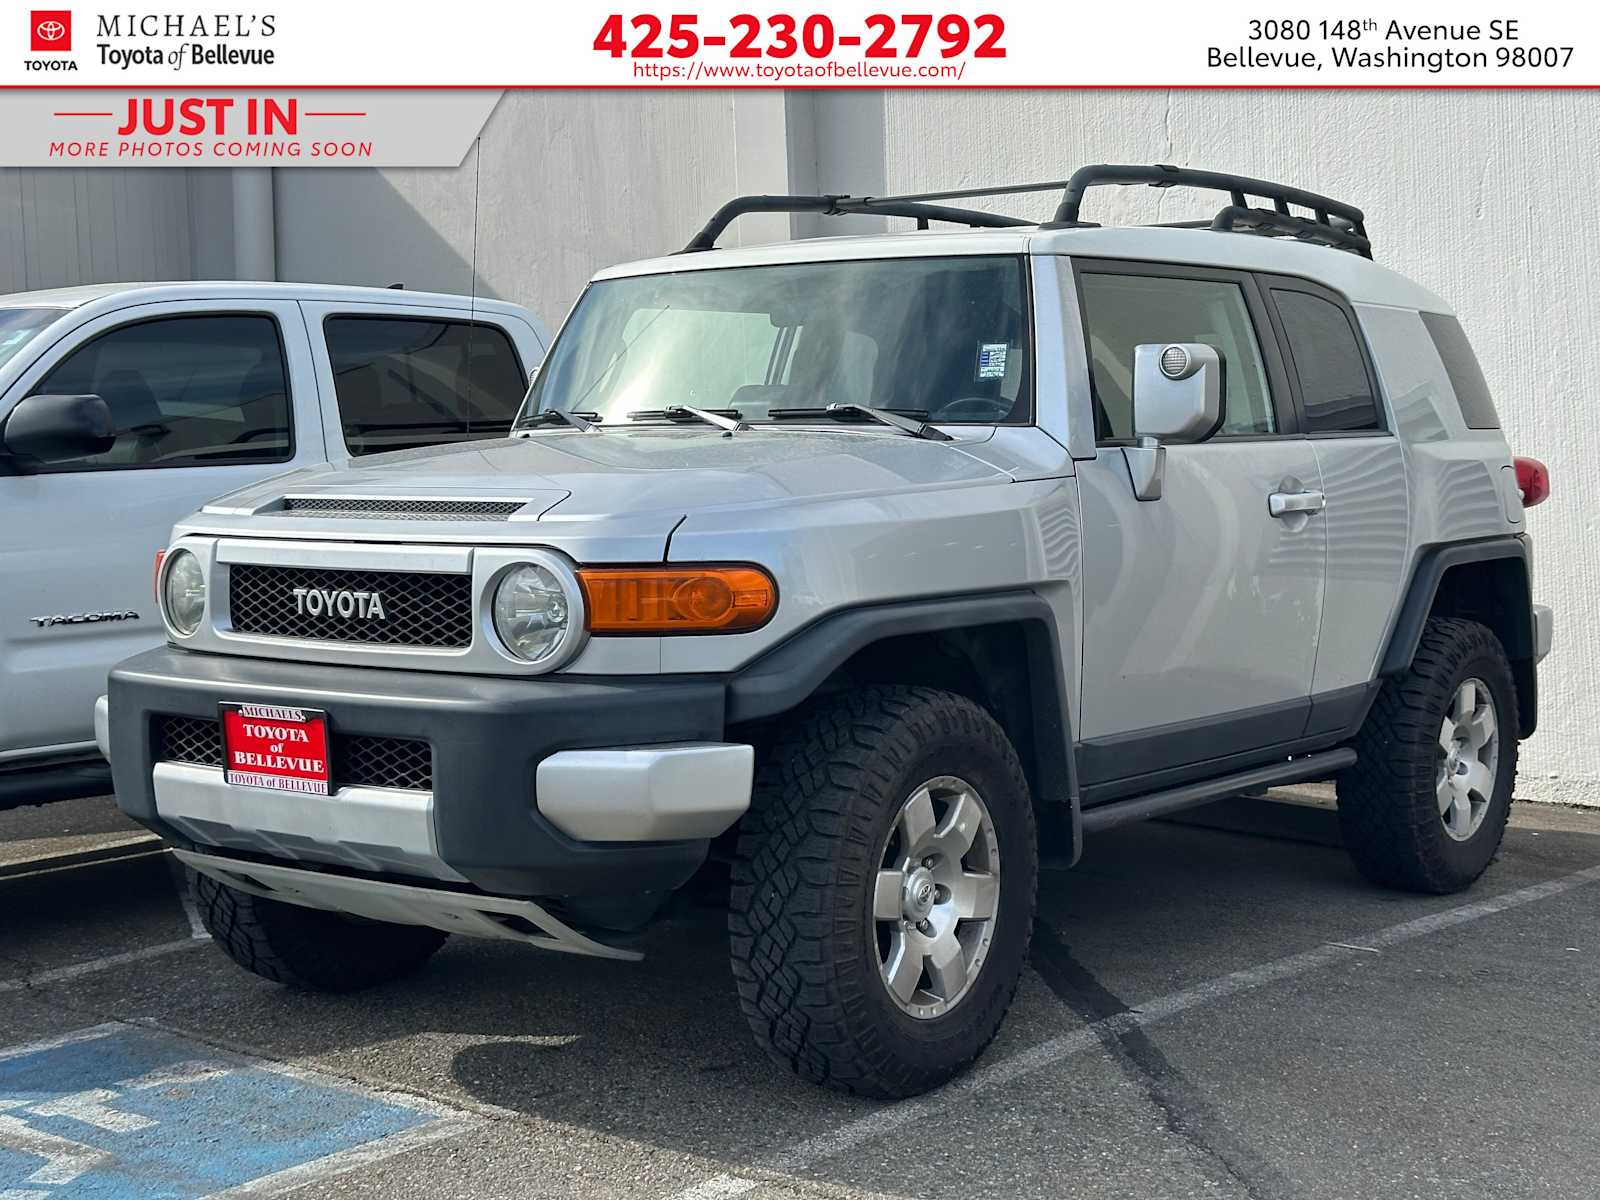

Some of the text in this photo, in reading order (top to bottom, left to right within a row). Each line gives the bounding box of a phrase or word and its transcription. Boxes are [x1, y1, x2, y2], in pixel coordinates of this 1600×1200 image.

[293, 588, 385, 620] TOYOTA
[30, 610, 140, 627] TACOMA
[243, 724, 309, 742] TOYOTA
[270, 743, 284, 753] of
[234, 751, 324, 772] BELLEVUE
[230, 773, 327, 793] TOYOTA of BELLEVUE
